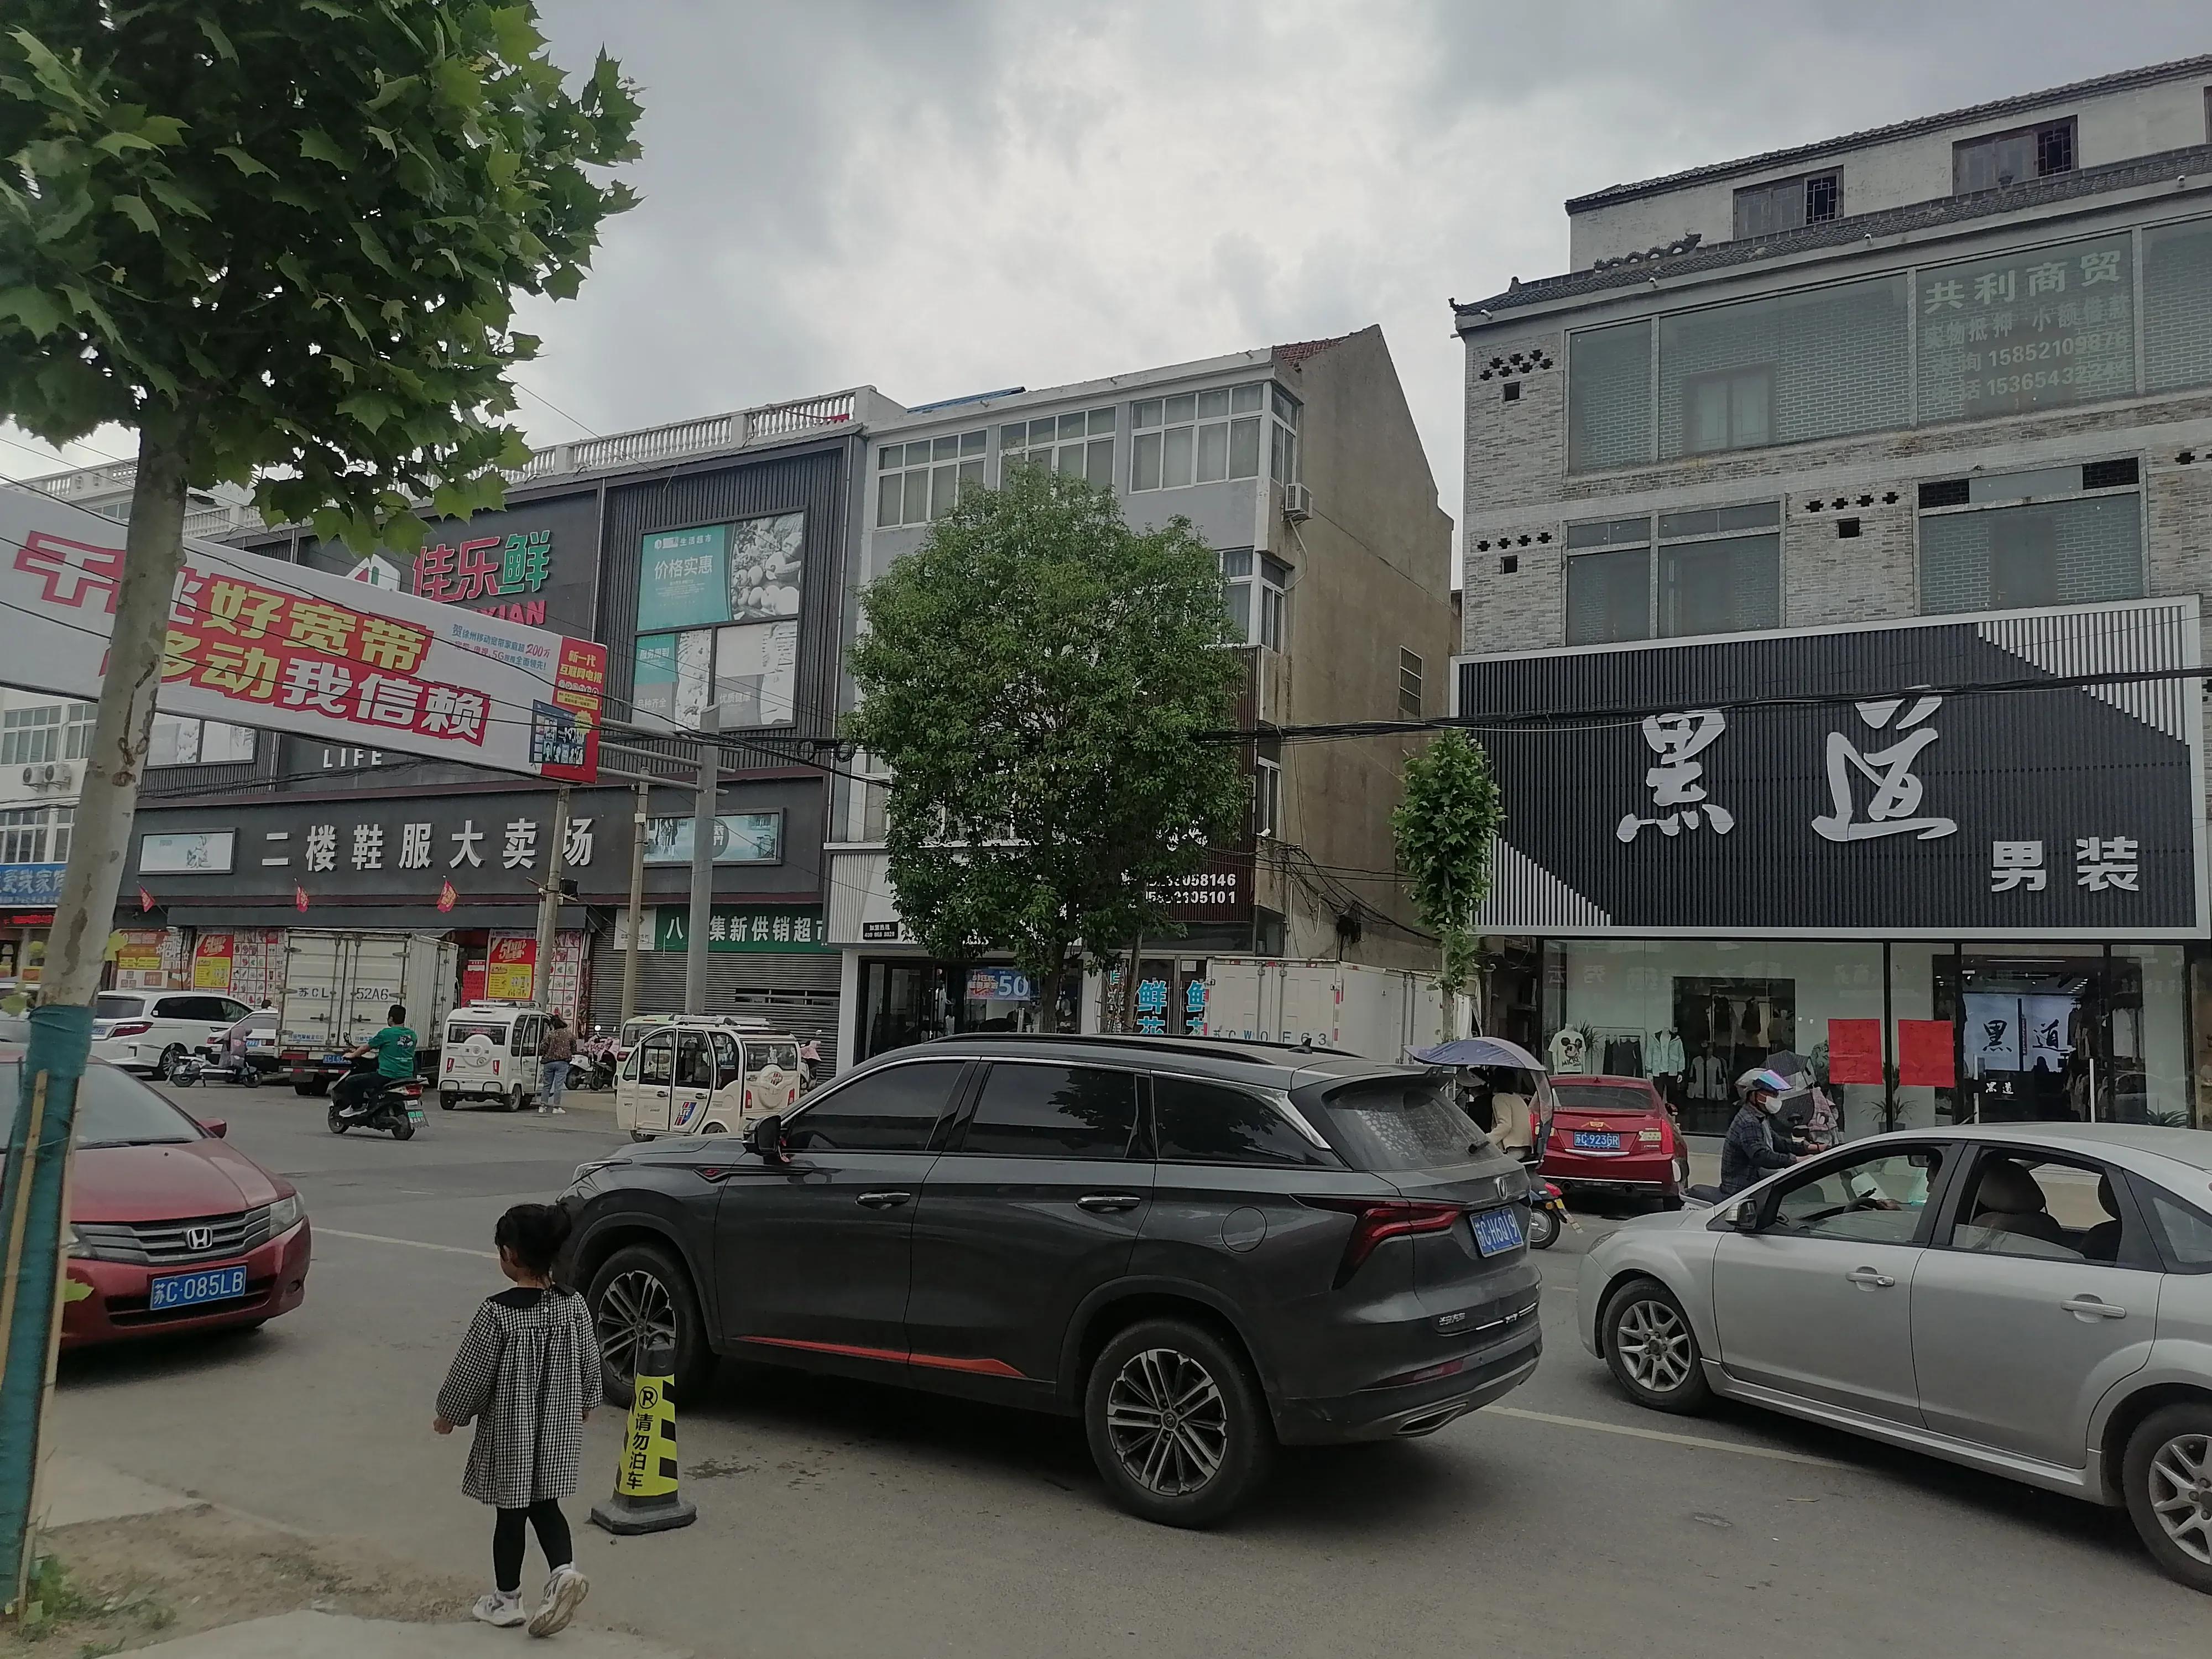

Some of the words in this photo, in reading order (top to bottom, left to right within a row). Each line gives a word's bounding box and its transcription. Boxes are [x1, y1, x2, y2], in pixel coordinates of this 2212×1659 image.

[1924, 250, 2120, 314] 共利商贸
[680, 534, 712, 546] 生活超市
[413, 529, 551, 603] 佳乐鲜
[655, 554, 713, 580] 价格实惠
[568, 650, 597, 667] 新一代
[559, 664, 603, 684] 互联网电视
[322, 748, 383, 769] LIFE
[262, 817, 594, 872] 二楼鞋服大卖场
[1991, 836, 2139, 891] 男装
[1146, 873, 1237, 886] 058146
[665, 915, 823, 942] 八集新供销超
[356, 988, 389, 1000] 52A6
[998, 975, 1029, 996] 50
[1982, 1019, 2069, 1052] 黑道
[626, 1412, 654, 1490] 请勿泊车
